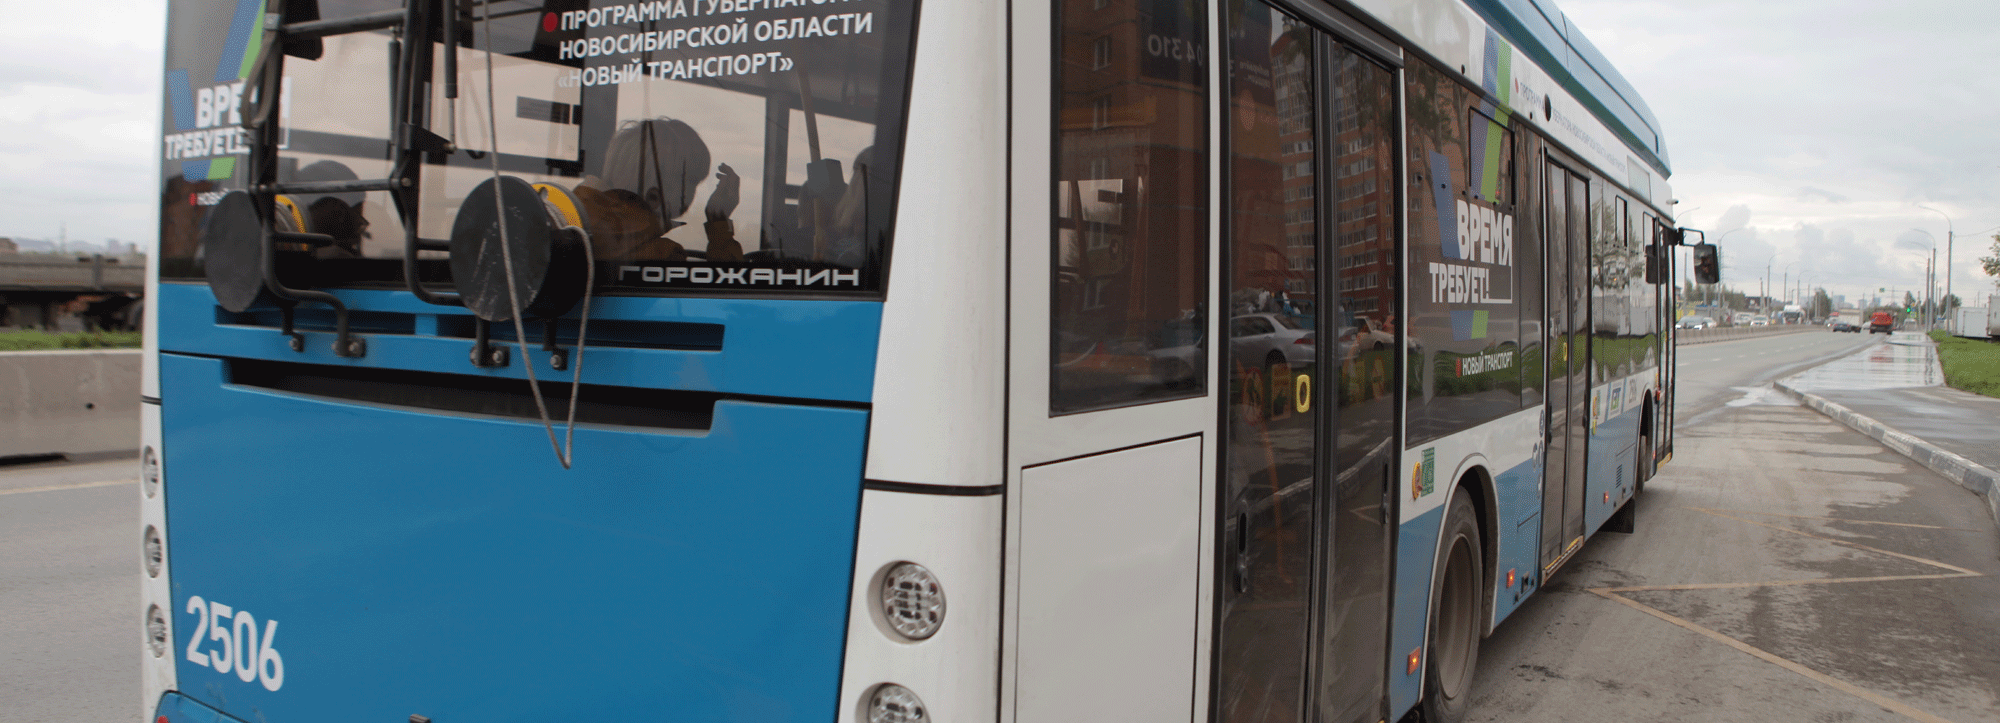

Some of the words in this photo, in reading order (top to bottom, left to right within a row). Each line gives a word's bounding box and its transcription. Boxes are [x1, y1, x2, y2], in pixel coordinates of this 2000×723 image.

[561, 0, 688, 31] ПРОГРАММА
[559, 17, 749, 60] НОВОСИБИРСКОЙ
[754, 12, 873, 42] ОБЛАСТИ
[558, 57, 643, 88] «НОВЫЙ
[647, 51, 794, 81] ТРАНСПОРТ»
[1457, 199, 1513, 267] ВРЕМЯ
[618, 266, 860, 286] ГОРОЖАНИН
[1429, 262, 1490, 304] ТРЕБУЕТ!
[1462, 350, 1484, 377] НОВЫЙ
[1484, 351, 1513, 372] ТРАНСПОРТ
[186, 595, 285, 692] 2506
